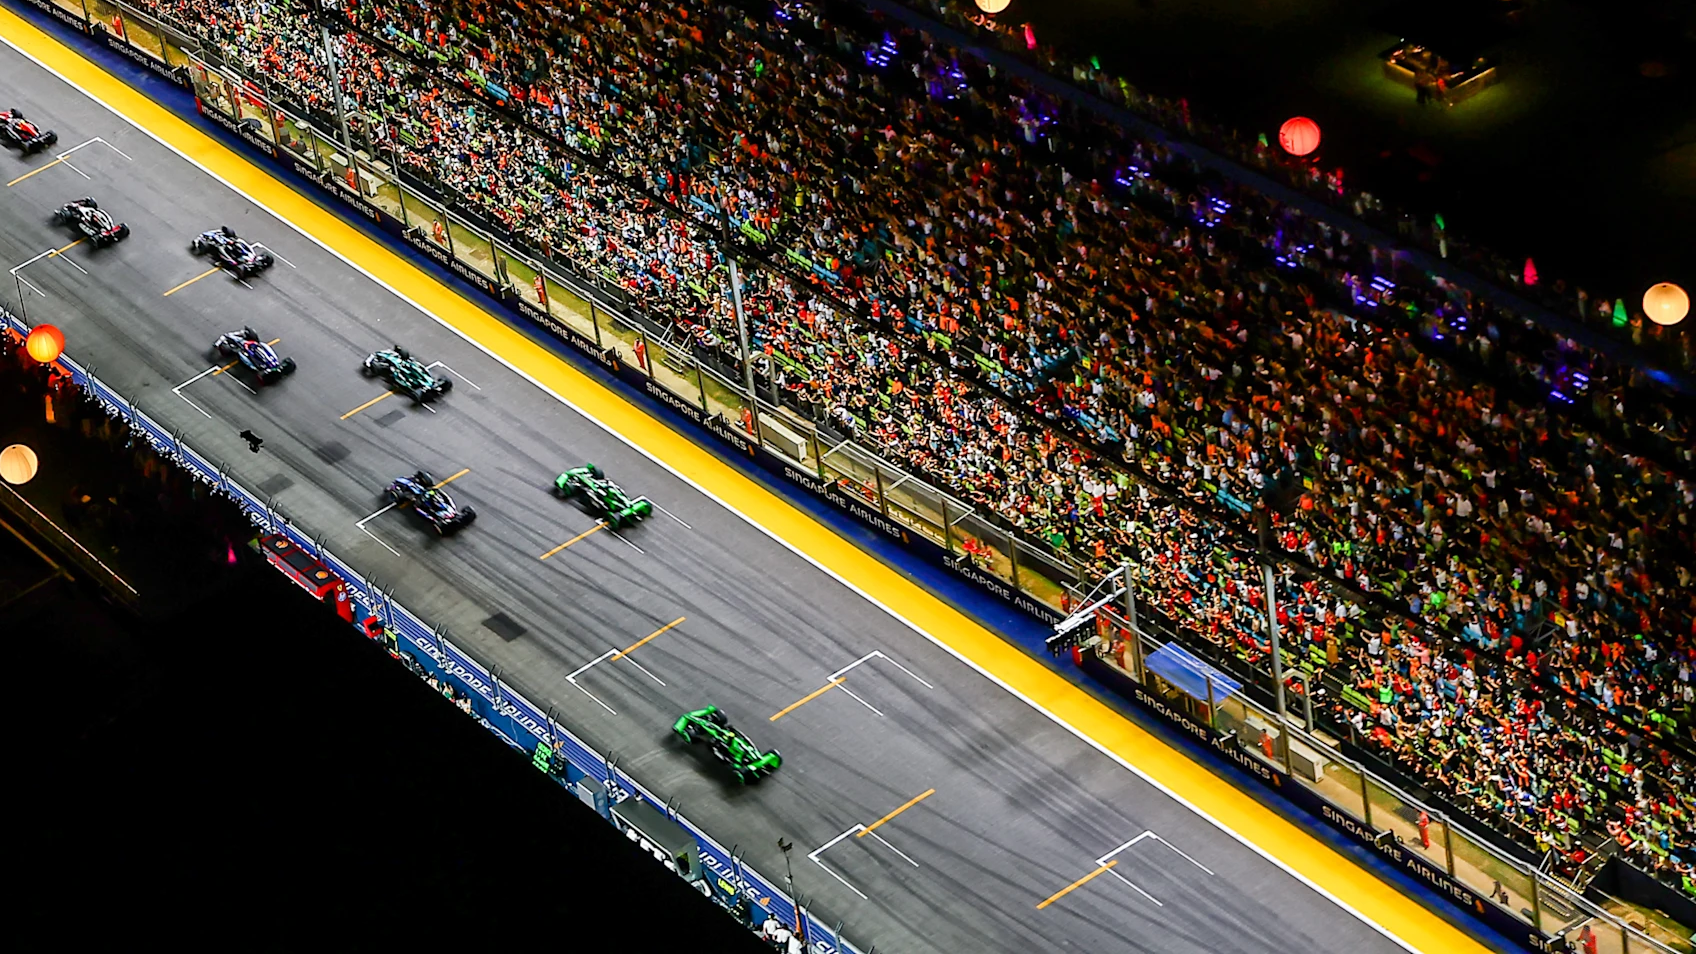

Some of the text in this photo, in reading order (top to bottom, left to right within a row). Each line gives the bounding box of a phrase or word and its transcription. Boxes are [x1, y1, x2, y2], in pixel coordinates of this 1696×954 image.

[108, 38, 149, 68] SINGAPORE
[340, 190, 375, 218] AIRLINES
[451, 260, 488, 290] AIRLINES
[518, 302, 569, 340] SINGAPORE
[646, 382, 701, 422] SINGAPORE
[850, 503, 900, 538] AIRLINES
[1135, 689, 1208, 740] SINGAPORE
[1407, 858, 1472, 906] AIRLINES
